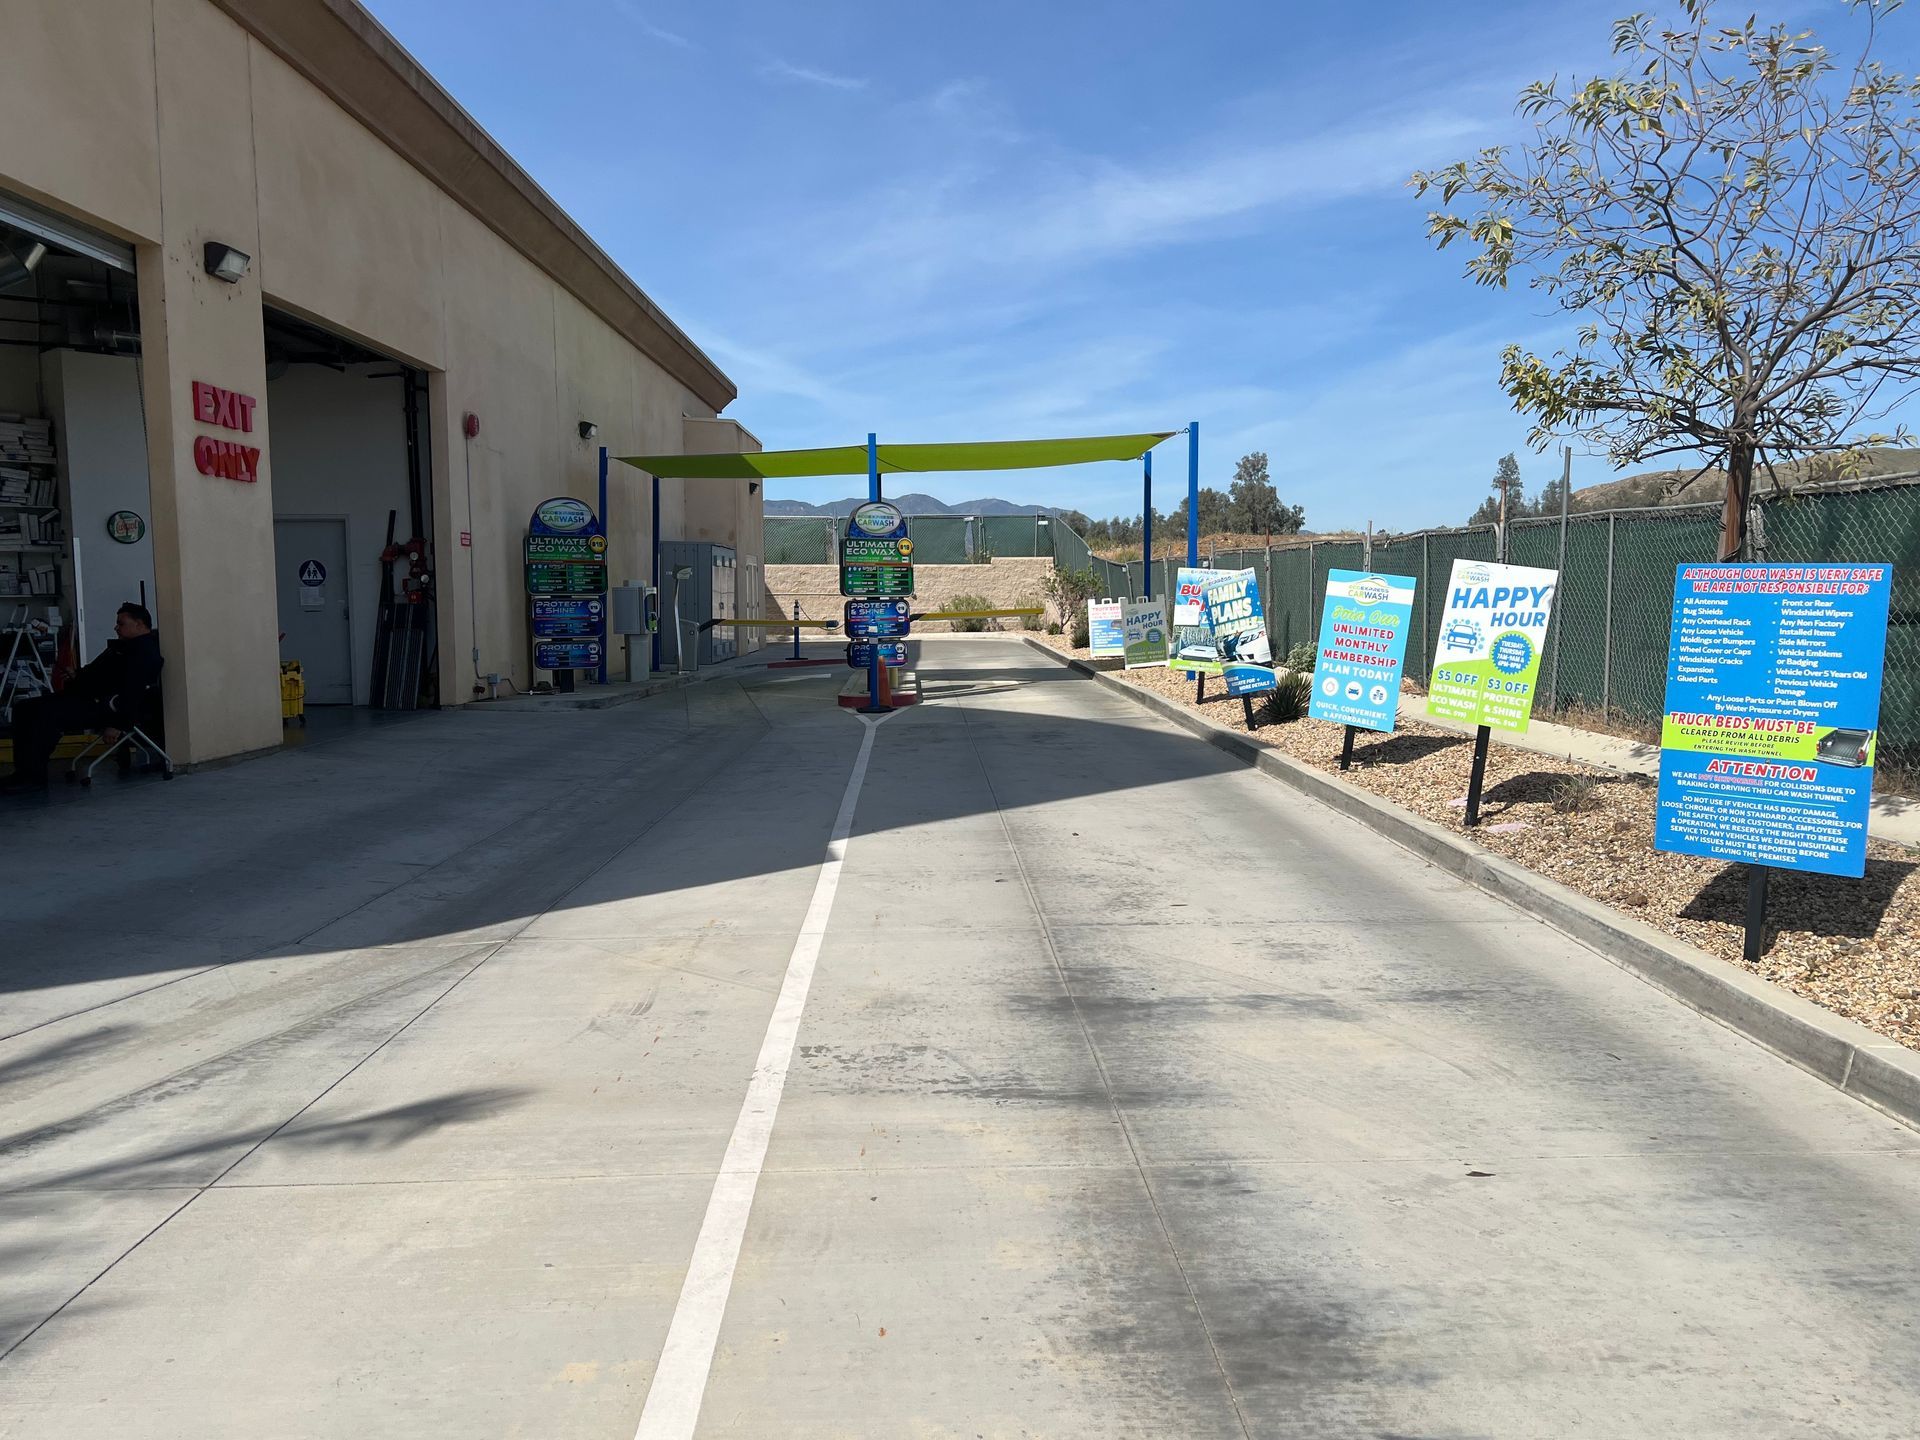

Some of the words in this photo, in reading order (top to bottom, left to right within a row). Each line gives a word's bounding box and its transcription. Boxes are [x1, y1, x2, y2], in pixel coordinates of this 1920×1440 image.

[192, 381, 256, 432] EXIT
[194, 436, 260, 483] ONLY
[542, 515, 584, 523] CARWASH
[1683, 568, 1740, 579] ALTHOUGH
[1743, 568, 1766, 580] OUR
[1769, 568, 1801, 580] WASH
[1804, 568, 1815, 580] IS
[1818, 568, 1850, 580] VERY
[1851, 569, 1882, 581] SAFE
[1207, 580, 1248, 606] FAMILY
[1348, 590, 1389, 600] CARWASH
[1693, 581, 1708, 592] WE
[1710, 581, 1732, 592] ARE
[1734, 582, 1757, 592] NOT
[1759, 582, 1838, 594] RESPONSIBLE
[1840, 583, 1869, 594] FOR:
[1451, 587, 1549, 609] HAPPY
[1126, 611, 1161, 626] HAPPY
[1211, 598, 1252, 625] PLANS
[1332, 606, 1366, 622] Join
[1369, 610, 1400, 627] Our
[1697, 608, 1723, 616] Shields
[1780, 608, 1823, 617] Windshield
[1824, 609, 1853, 618] Wipers
[1142, 620, 1163, 629] HOUR
[1490, 612, 1546, 627] HOUR
[1696, 618, 1732, 626] Overhead
[1780, 618, 1795, 627] Any
[1795, 619, 1813, 627] Non
[1814, 619, 1844, 628] Factory
[1334, 624, 1394, 639] UNLIMITED
[1335, 637, 1389, 652] MONTHLY
[1680, 636, 1712, 644] Moldings
[1722, 637, 1755, 646] Bumpers
[1323, 649, 1397, 667] MEMBERSHIP
[1679, 646, 1701, 654] Wheel
[1702, 646, 1722, 654] Cover
[1733, 648, 1751, 656] Caps
[1806, 650, 1842, 658] Emblems
[1678, 655, 1717, 664] Windshield
[1785, 658, 1818, 667] Badging
[1322, 662, 1350, 676] PLAN
[1353, 667, 1394, 682] TODAY!
[1677, 665, 1713, 674] Expansion
[1775, 668, 1803, 676] Vehicle
[1829, 670, 1851, 678] Years
[1438, 669, 1450, 681] $5
[1454, 672, 1478, 686] OFF
[1774, 678, 1808, 686] Previous
[1808, 680, 1838, 688] Vehicle
[1433, 683, 1478, 698] ULTIMATE
[1487, 678, 1501, 690] $3
[1504, 681, 1529, 694] OFF
[1773, 687, 1805, 696] Damage
[1430, 695, 1447, 705] ECO
[1449, 697, 1476, 710] WASH
[1483, 692, 1529, 707] PROTECT
[1330, 711, 1378, 727] AFFORDABLE!
[1484, 704, 1491, 712] &
[1493, 705, 1523, 719] SHINE
[1669, 711, 1712, 728] TRUCK
[1715, 714, 1750, 730] BEDS
[1753, 717, 1794, 734] MUST
[1796, 720, 1815, 735] BE
[1680, 727, 1718, 737] CLEARED
[1720, 730, 1745, 739] FROM
[1747, 732, 1764, 740] ALL
[1766, 734, 1800, 743] DEBRIS
[1706, 758, 1818, 782] ATTENTION
[1676, 779, 1707, 788] BRAKING
[1720, 784, 1750, 792] DRIVING
[1751, 786, 1773, 795] THRU
[1790, 790, 1812, 799] WASH
[1661, 800, 1683, 810] LOOSE
[1684, 803, 1716, 813] CHROME,
[1717, 806, 1728, 815] OR
[1728, 808, 1745, 817] NON
[1746, 810, 1786, 821] STANDARD
[1670, 825, 1698, 834] SERVICE
[1708, 829, 1725, 837] ANY
[1725, 831, 1759, 842] VEHICLES
[1774, 837, 1796, 846] DEEM
[1796, 840, 1847, 852] UNSUITABLE.
